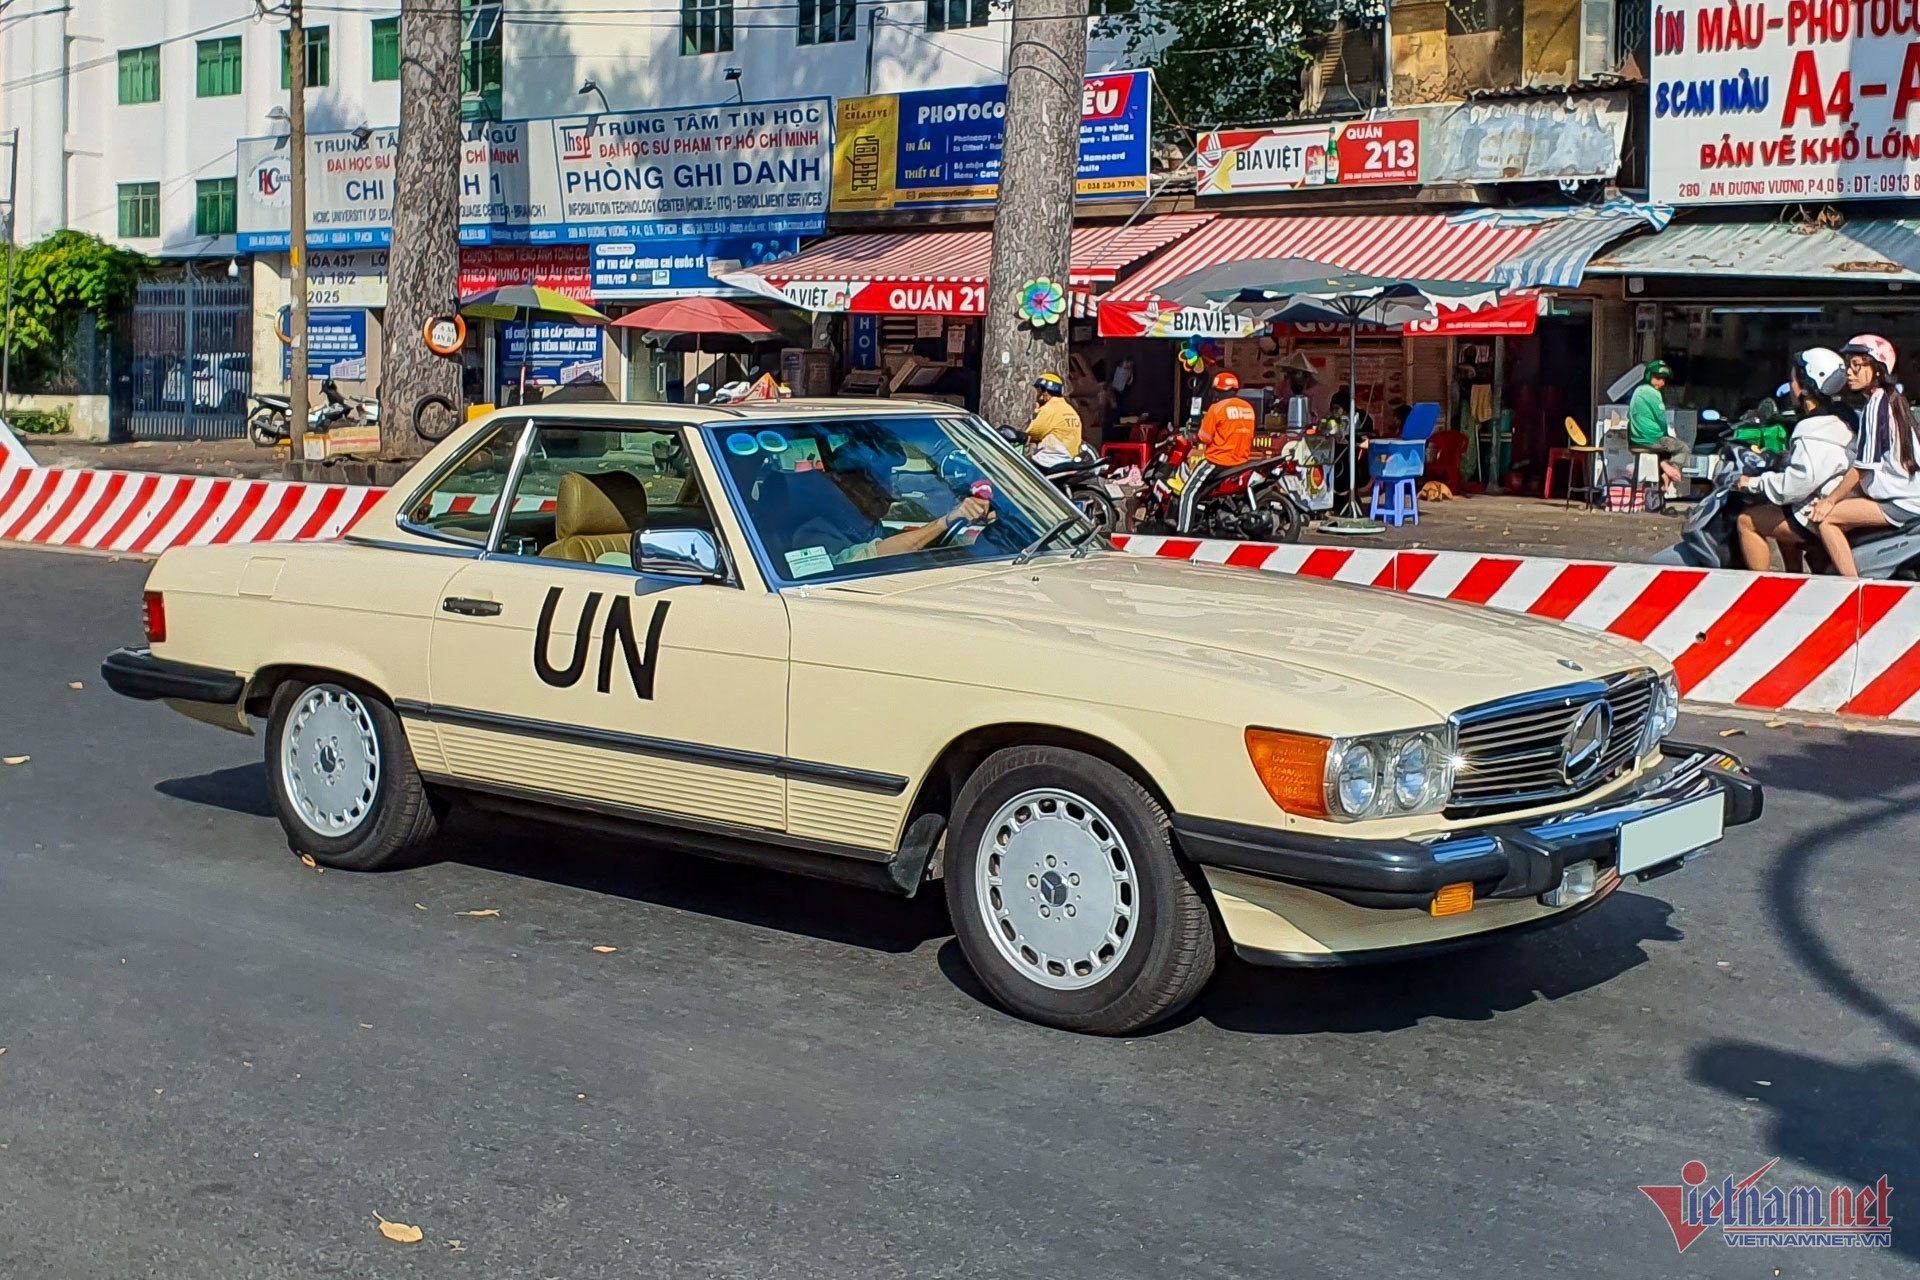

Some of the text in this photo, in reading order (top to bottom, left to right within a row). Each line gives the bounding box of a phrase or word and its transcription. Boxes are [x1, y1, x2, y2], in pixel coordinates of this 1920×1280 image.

[1655, 80, 1714, 118] SCAN
[597, 107, 820, 137] TRUNG TÂM TIN HỌC
[918, 101, 1006, 124] PHOTOCO
[376, 131, 399, 150] TÂ
[600, 141, 620, 158] ĐẠI
[622, 139, 649, 157] HỌC
[653, 139, 670, 155] SƯ
[675, 135, 712, 153] PHẠM
[785, 130, 819, 147] MINH
[1346, 126, 1382, 140] QUÁN
[1364, 139, 1415, 170] 213
[1701, 134, 1754, 169] BẢN
[1801, 123, 1860, 165] KHỔ
[1866, 127, 1920, 162] LỚN
[327, 158, 346, 173] ĐẠI
[349, 156, 372, 172] HỌC
[566, 158, 820, 194] PHÒNG GHI DANH
[346, 179, 384, 200] CHI
[1679, 183, 1700, 197] 280
[1709, 182, 1725, 197] AN
[333, 254, 355, 267] 437
[331, 271, 356, 285] 18/2
[462, 268, 487, 283] THEO
[488, 267, 520, 282] KHUNG
[307, 290, 340, 304] 2025
[889, 285, 985, 312] QUÁN 21
[534, 587, 671, 701] UN
